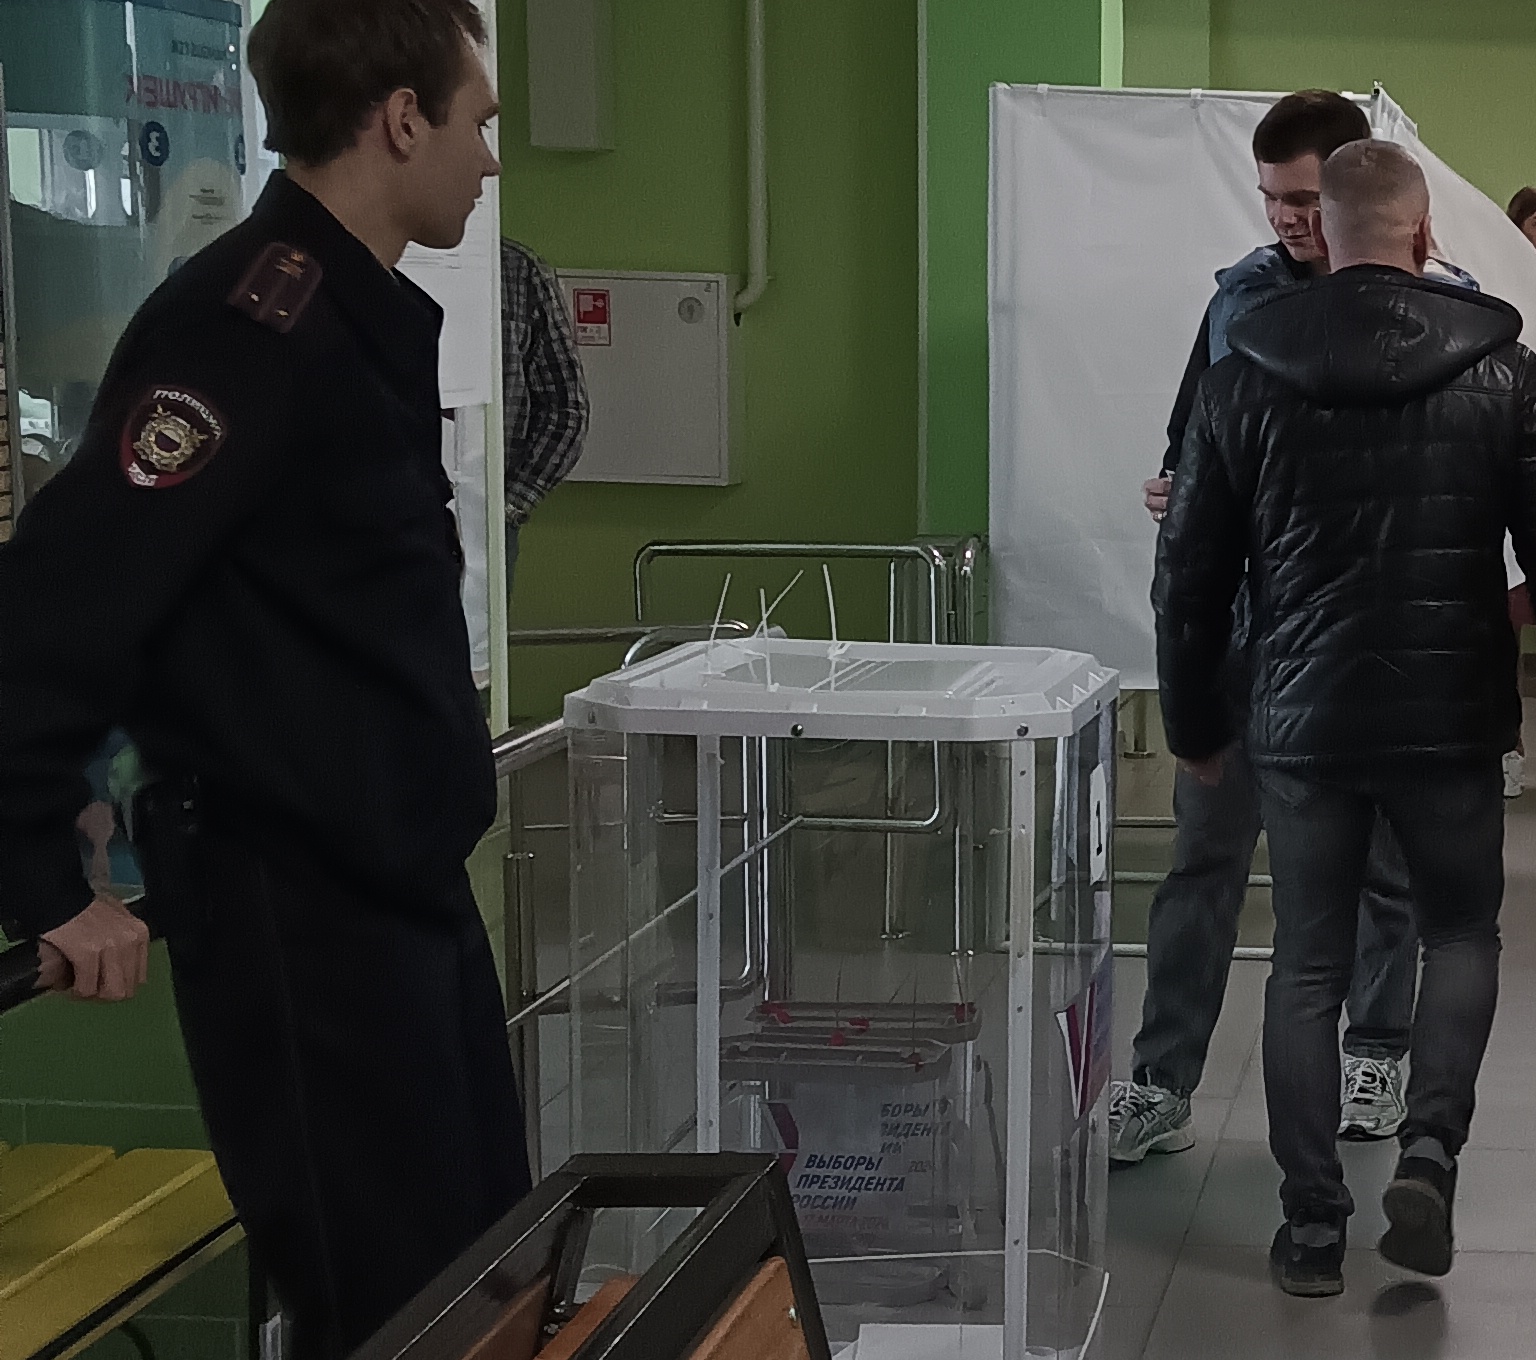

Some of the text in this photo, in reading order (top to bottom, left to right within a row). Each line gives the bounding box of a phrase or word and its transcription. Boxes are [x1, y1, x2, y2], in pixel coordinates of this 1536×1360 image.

[805, 1153, 883, 1171] ВЫБОРЫ
[795, 1174, 906, 1193] ПРЕЗИДЕНТА
[792, 1194, 857, 1211] РОССИИ
